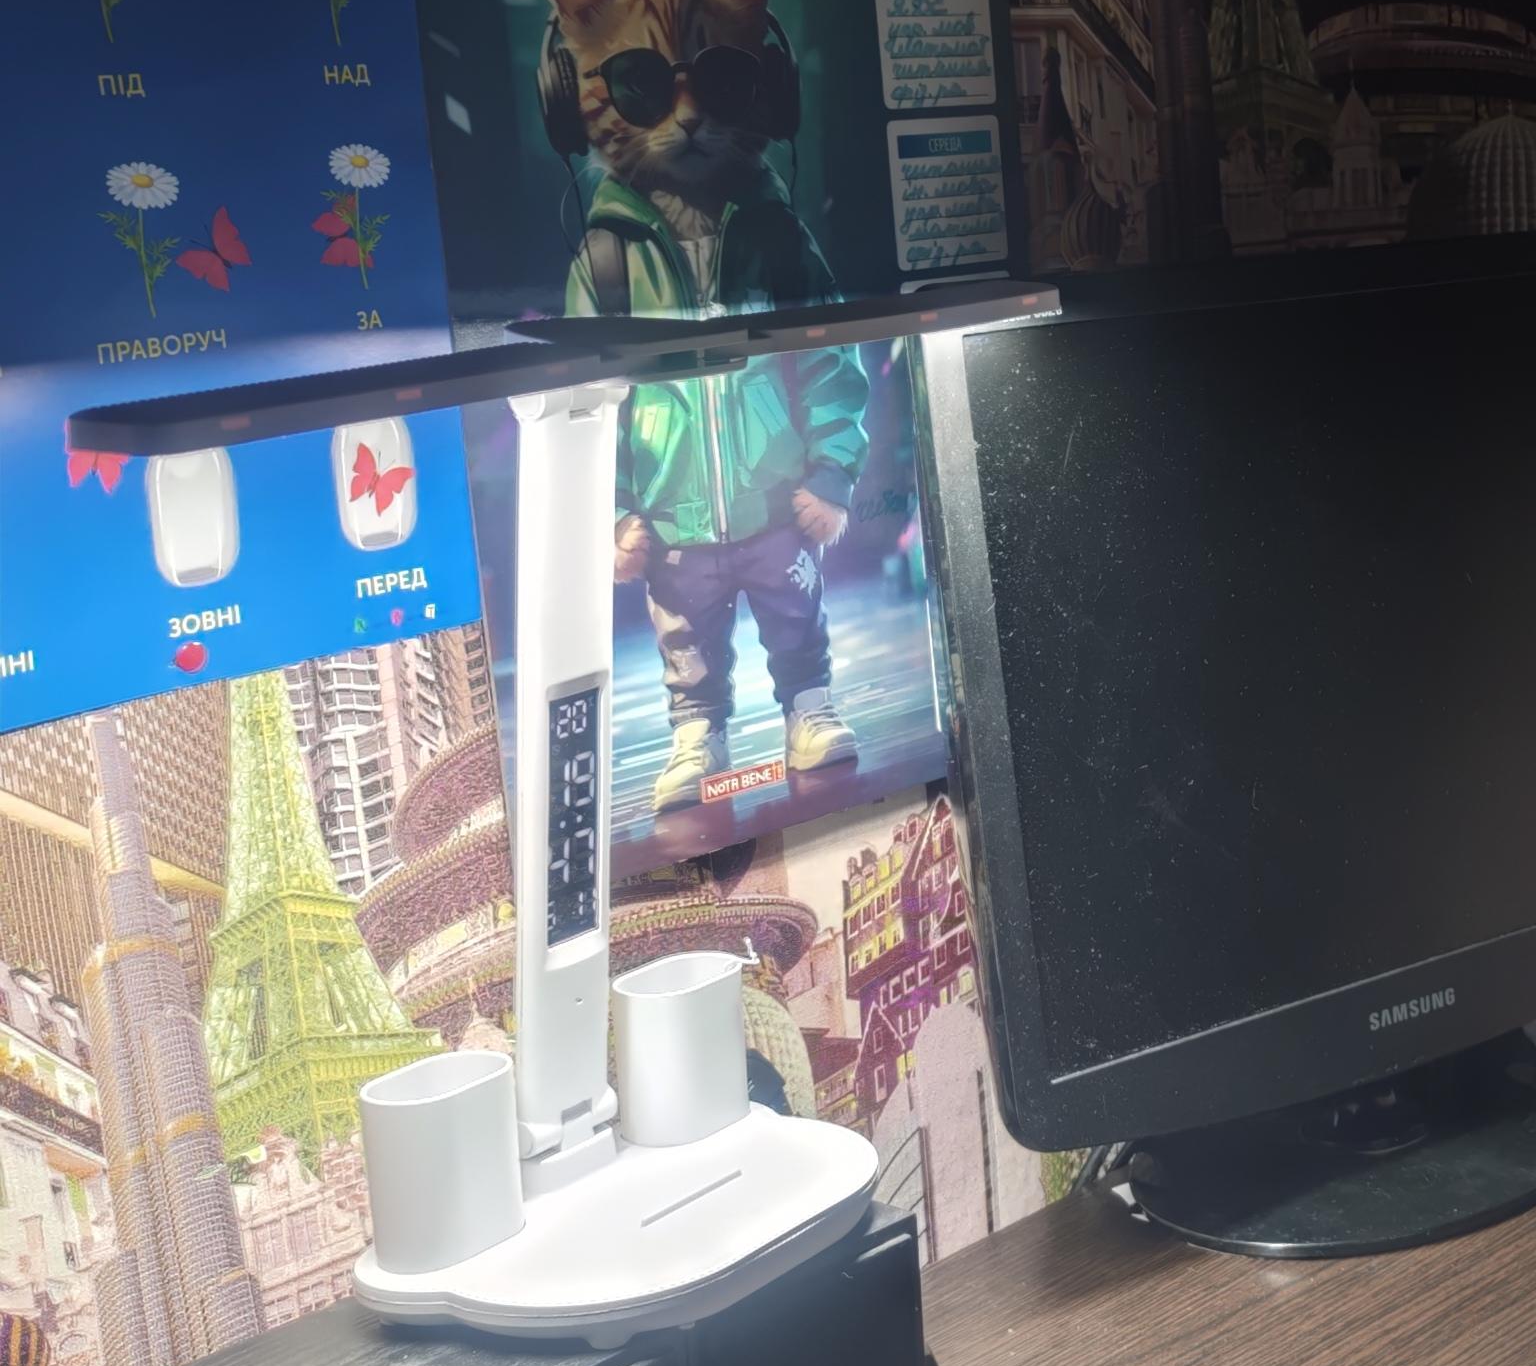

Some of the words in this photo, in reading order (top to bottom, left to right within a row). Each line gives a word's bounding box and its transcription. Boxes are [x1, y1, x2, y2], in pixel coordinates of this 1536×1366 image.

[97, 73, 147, 99] ПІД
[323, 64, 372, 88] НАД
[356, 310, 384, 331] ЗА
[97, 328, 227, 365] ПРАВОРУЧ
[356, 567, 428, 599] ПЕРЕД
[168, 603, 242, 638] ЗОВНІ
[556, 699, 587, 739] 20
[707, 778, 740, 798] NOTA
[742, 768, 772, 788] BENE
[1368, 987, 1456, 1032] SAMSUNG
